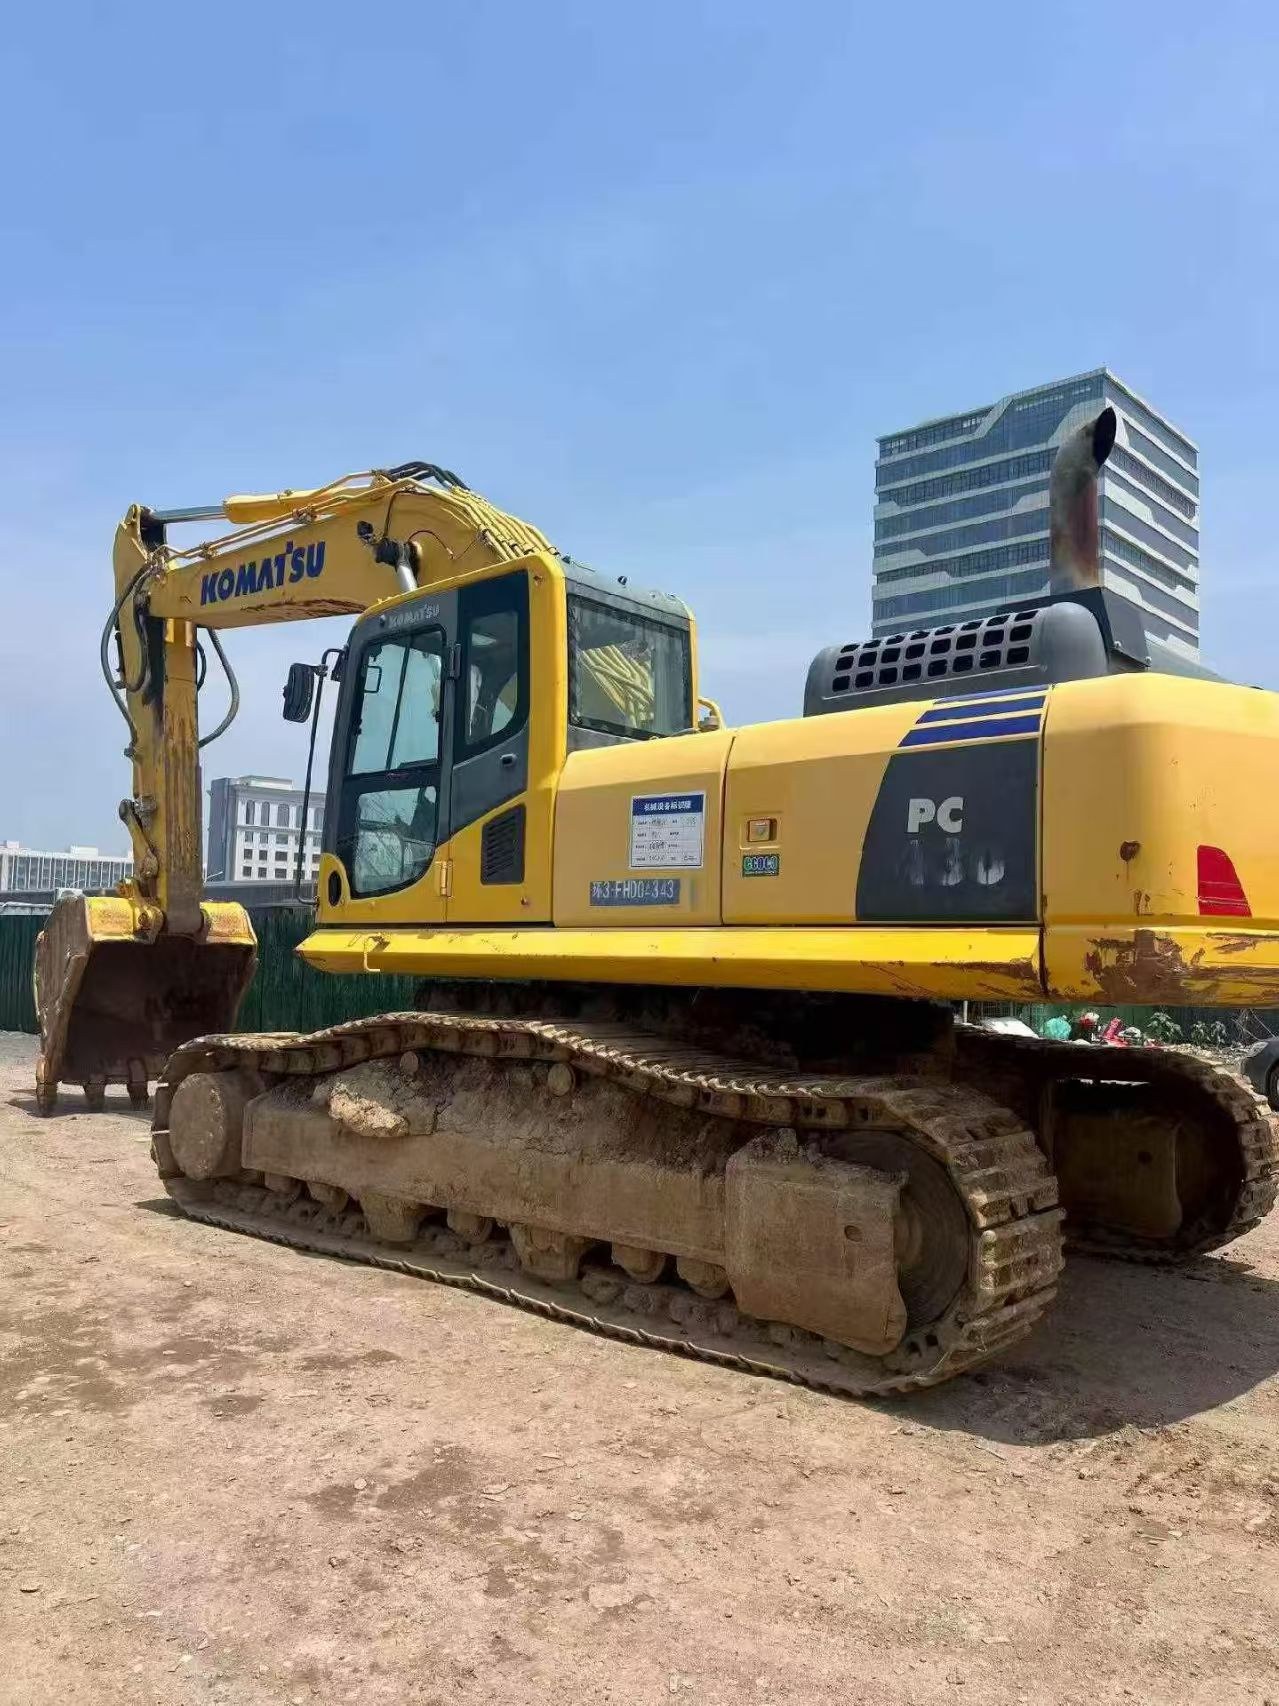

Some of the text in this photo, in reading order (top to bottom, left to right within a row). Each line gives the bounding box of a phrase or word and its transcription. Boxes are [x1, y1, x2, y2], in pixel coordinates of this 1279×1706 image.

[200, 540, 325, 606] KOMATSU
[388, 604, 440, 629] KOMATSU
[906, 796, 964, 834] PC
